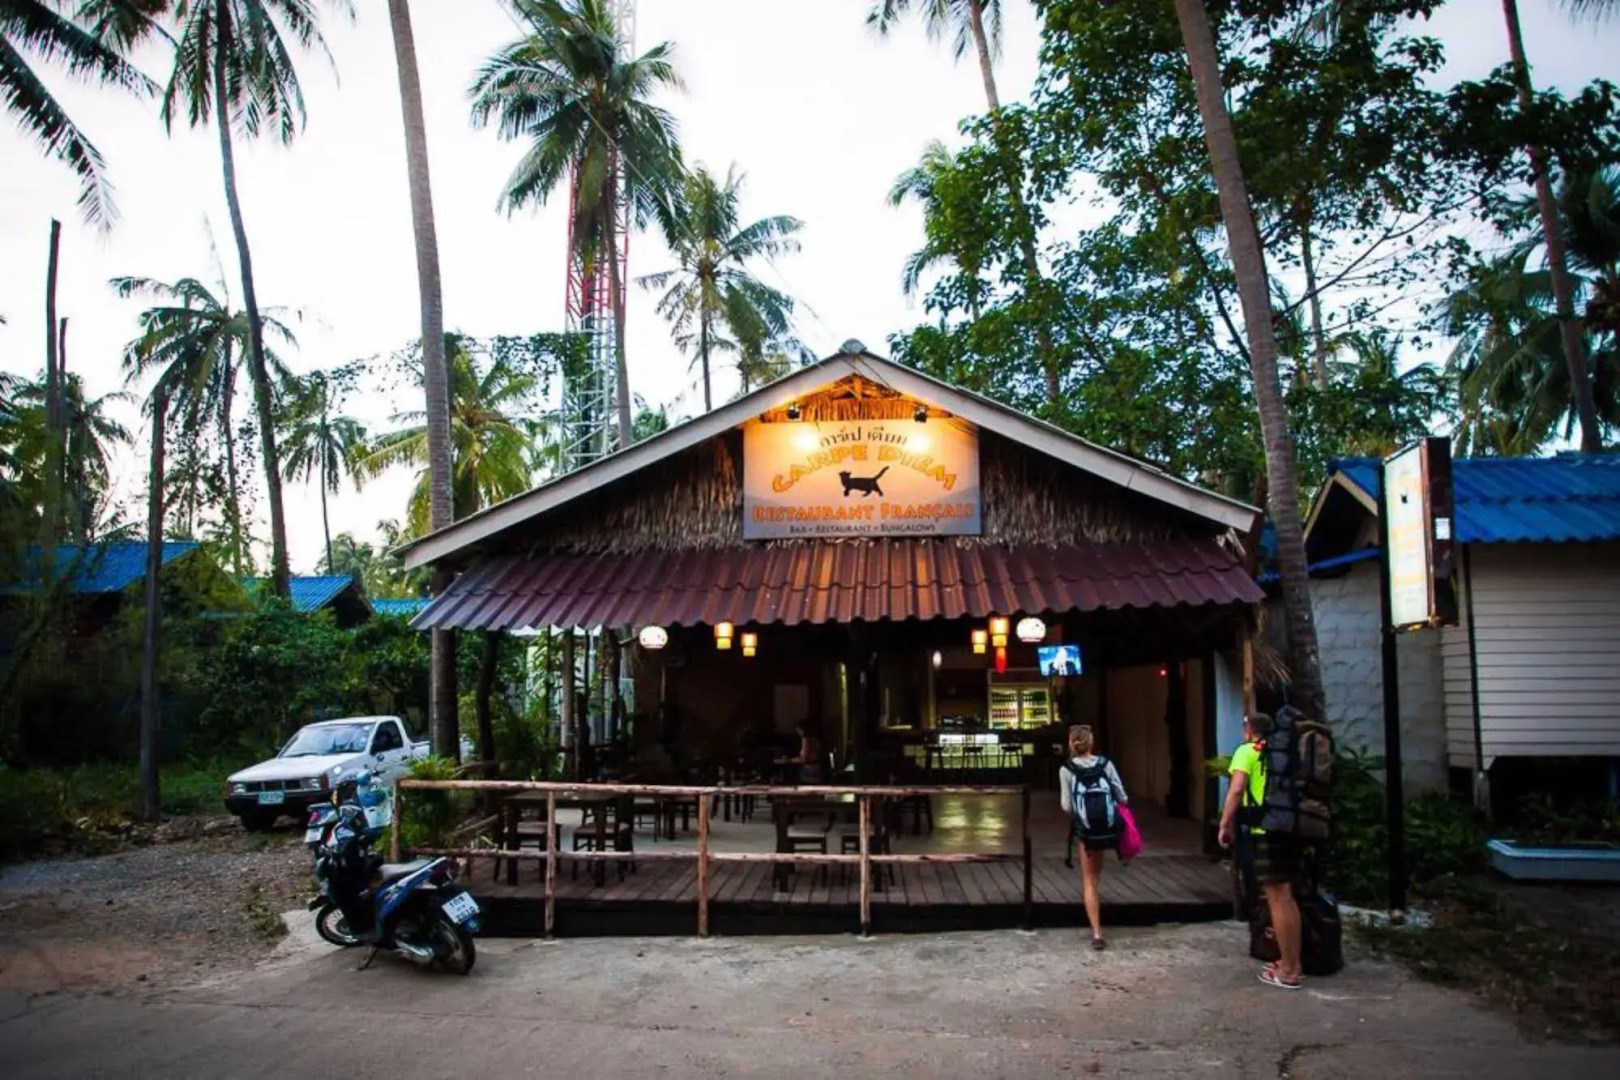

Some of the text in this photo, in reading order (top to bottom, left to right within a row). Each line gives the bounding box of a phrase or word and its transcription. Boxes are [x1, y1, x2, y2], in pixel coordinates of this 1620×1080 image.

[772, 444, 957, 492] CARPE DIEM
[754, 503, 974, 523] RESTAURANT FRANÇAIS
[789, 523, 936, 534] BAR RESTAURANT BUNGALOWS
